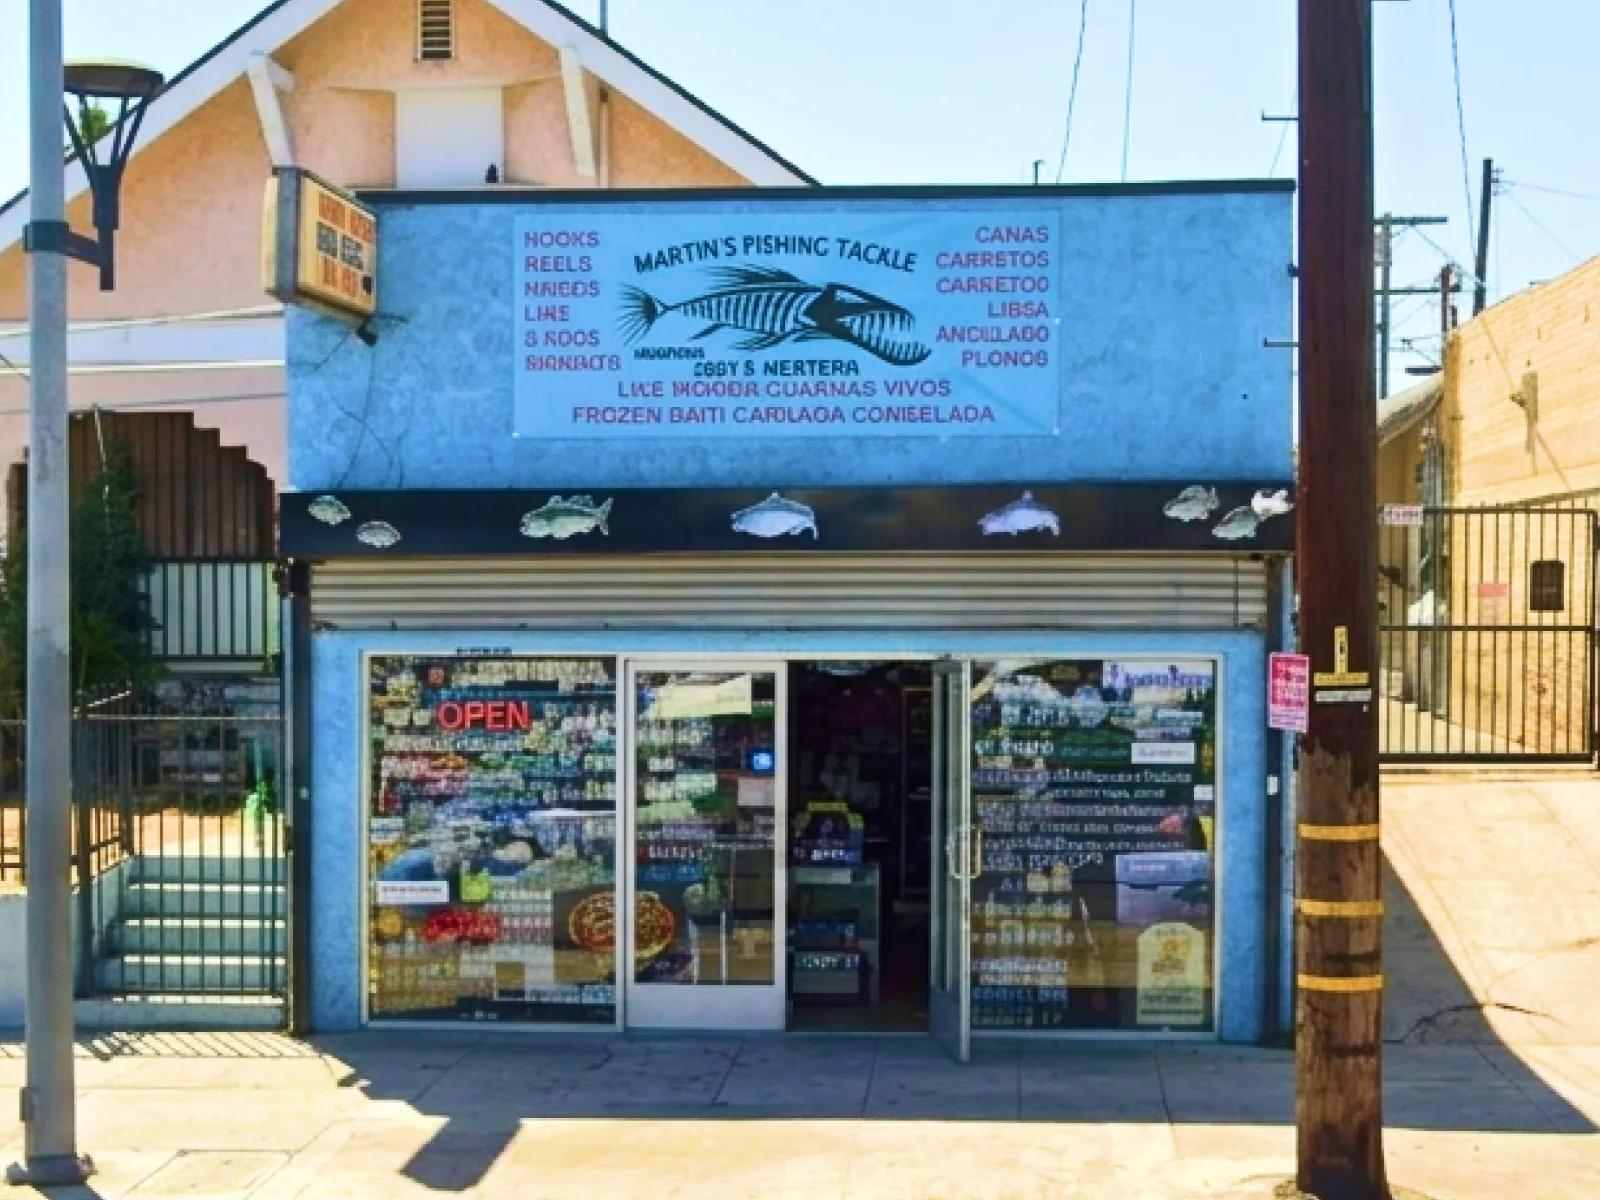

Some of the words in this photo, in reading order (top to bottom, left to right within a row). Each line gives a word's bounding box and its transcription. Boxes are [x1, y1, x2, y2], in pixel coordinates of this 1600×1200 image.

[634, 237, 737, 273] MARTIN'S
[836, 238, 918, 272] TACKLE
[572, 406, 662, 423] FROZEN
[437, 700, 531, 731] OPEN
